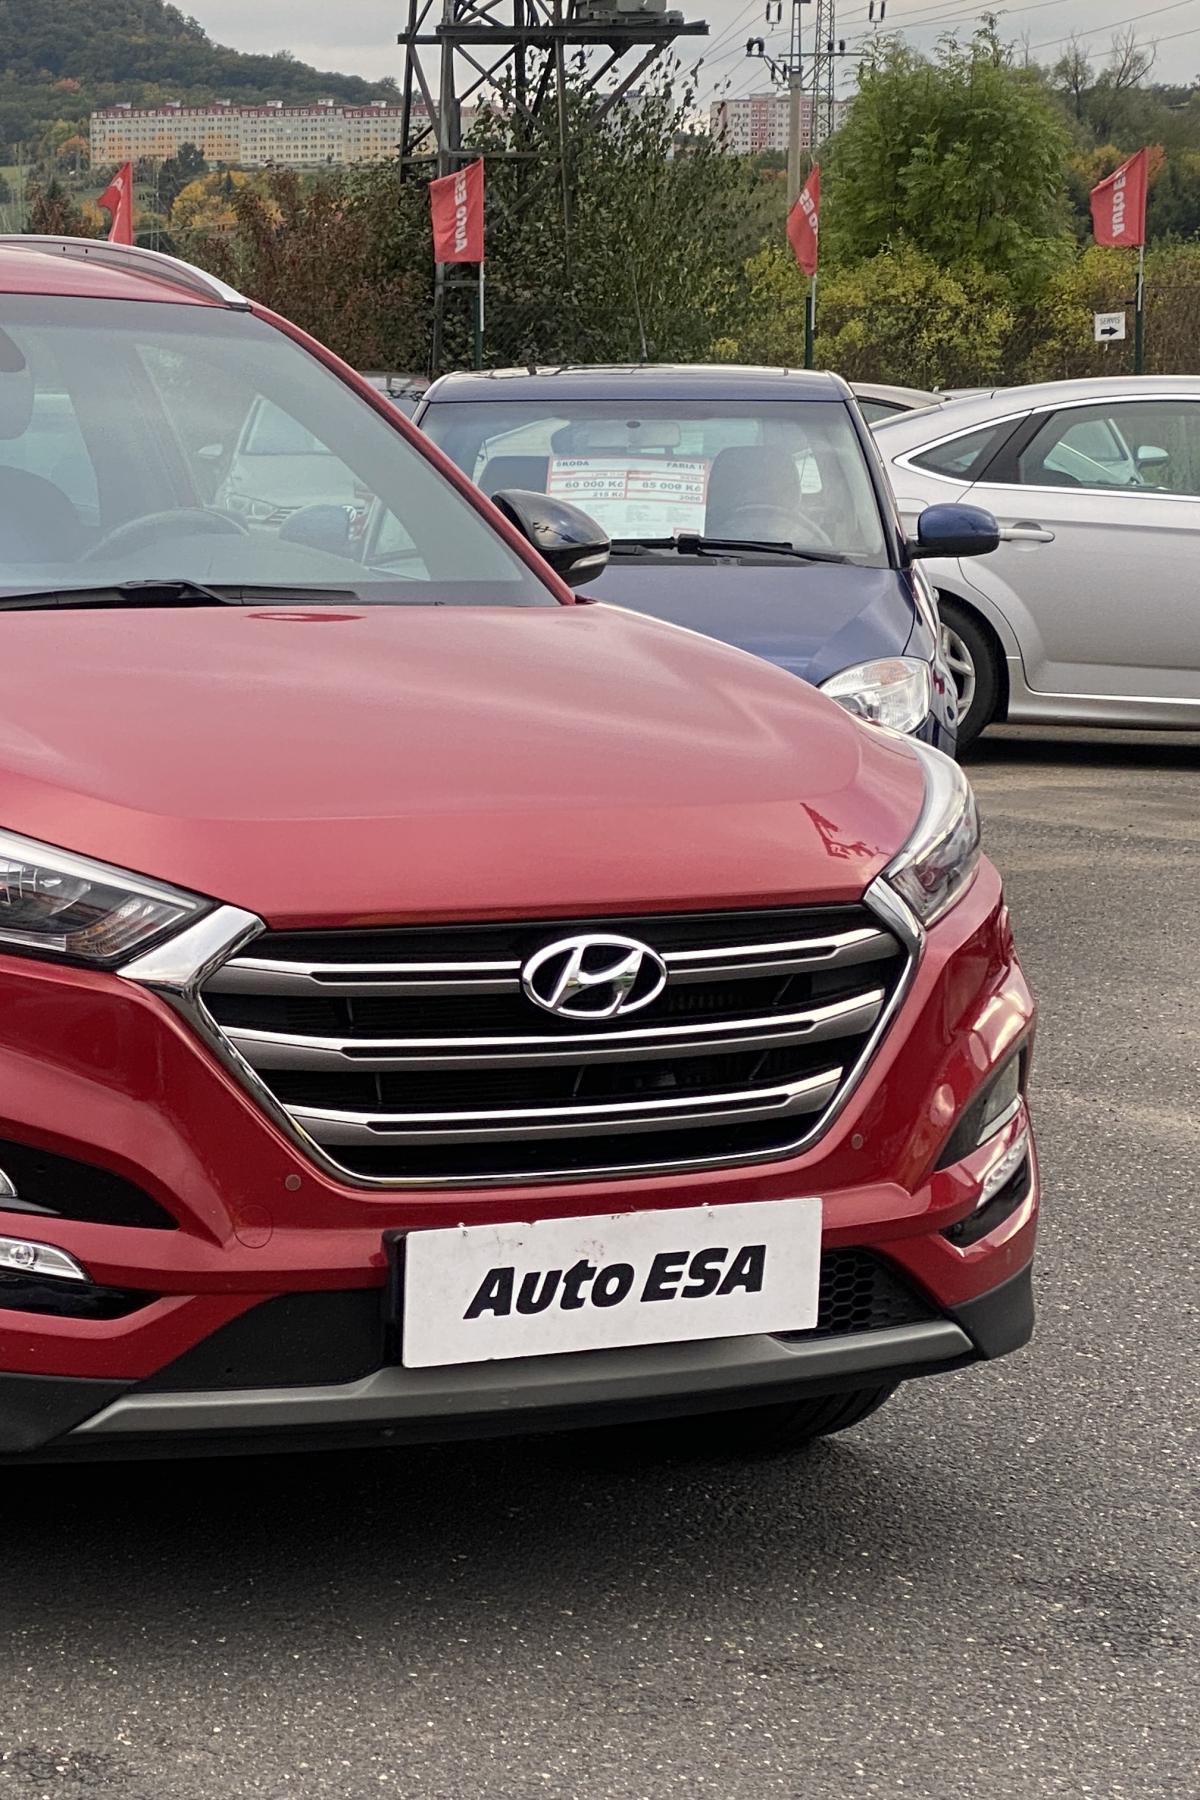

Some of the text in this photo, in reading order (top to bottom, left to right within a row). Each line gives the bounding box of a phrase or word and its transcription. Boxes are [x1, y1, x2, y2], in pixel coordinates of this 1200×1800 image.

[666, 462, 696, 470] FABIA
[462, 1244, 768, 1321] Auto ESA
